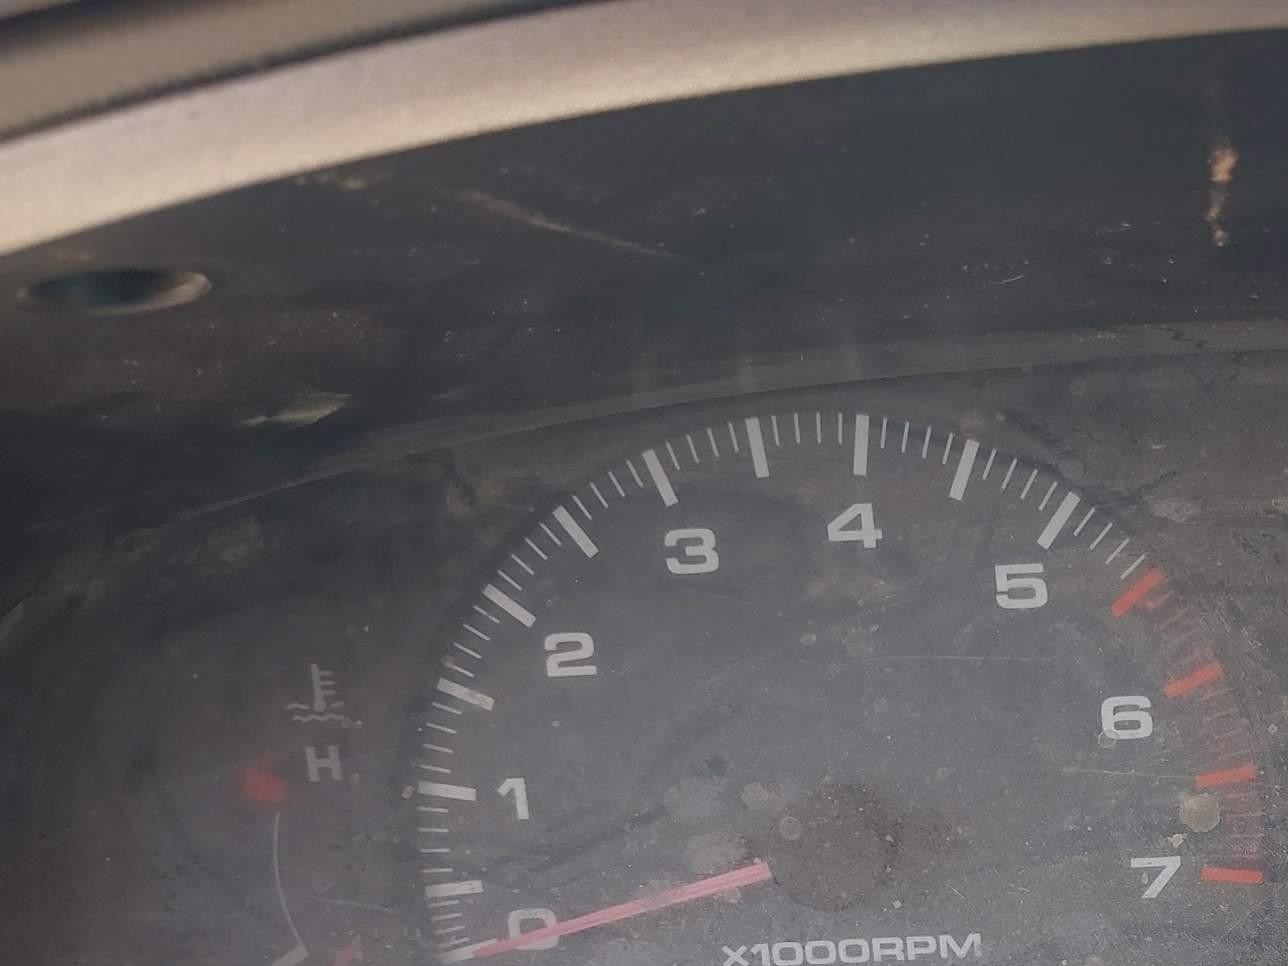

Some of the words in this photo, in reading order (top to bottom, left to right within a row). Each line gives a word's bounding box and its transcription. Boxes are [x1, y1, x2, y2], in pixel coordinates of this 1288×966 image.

[827, 503, 882, 549] 4
[664, 528, 719, 575] 3
[994, 563, 1049, 609] 5
[544, 632, 597, 677] 2
[1101, 695, 1154, 740] 6
[305, 745, 343, 782] H
[497, 777, 530, 820] 1
[1131, 855, 1182, 899] 7
[507, 908, 560, 952] 0
